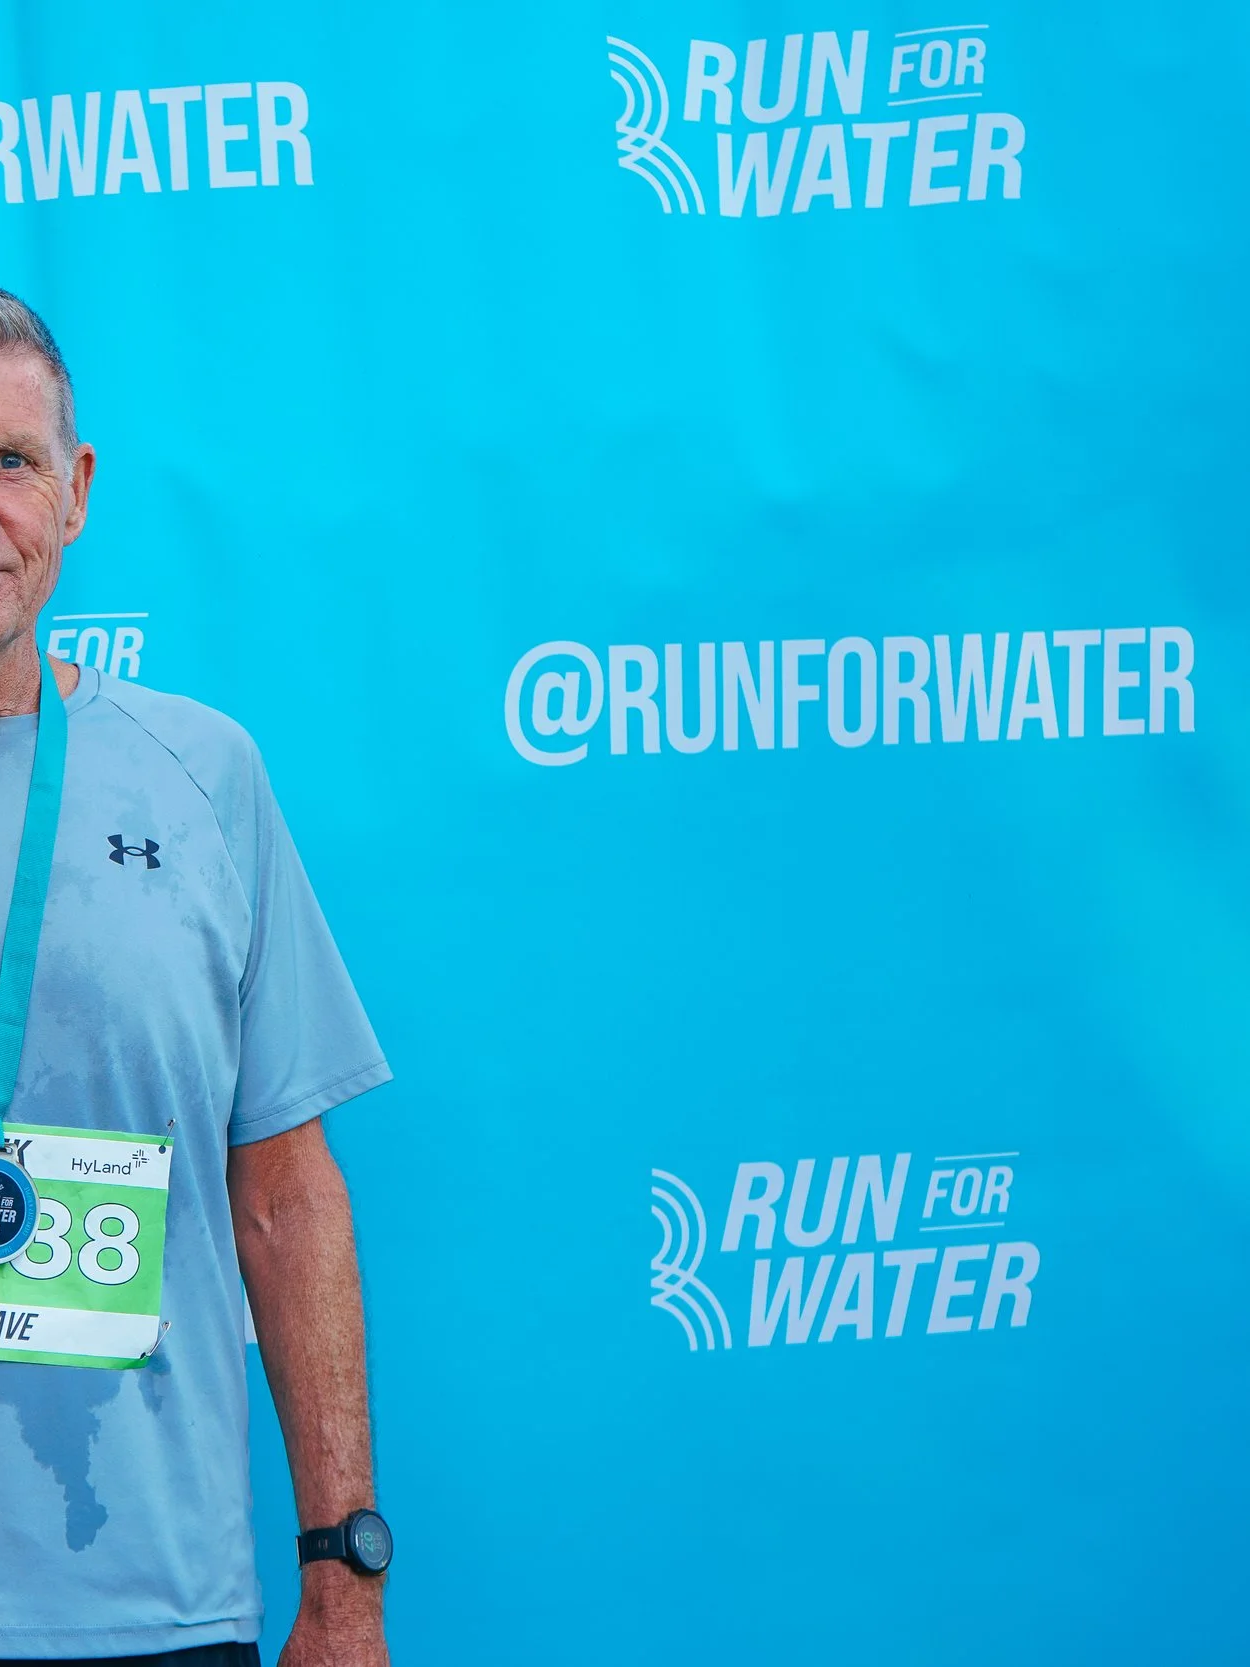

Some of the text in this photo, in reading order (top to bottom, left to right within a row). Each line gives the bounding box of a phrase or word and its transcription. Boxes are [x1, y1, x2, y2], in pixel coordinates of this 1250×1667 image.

[683, 30, 987, 125] RUN FOR
[717, 113, 1026, 218] WATER
[46, 626, 144, 678] FOR
[504, 626, 1195, 766] @RUNFORWATER
[1, 1198, 14, 1207] FOR
[71, 1158, 131, 1175] HyLand
[720, 1153, 1014, 1252] RUN FOR
[747, 1241, 1041, 1348] WATER
